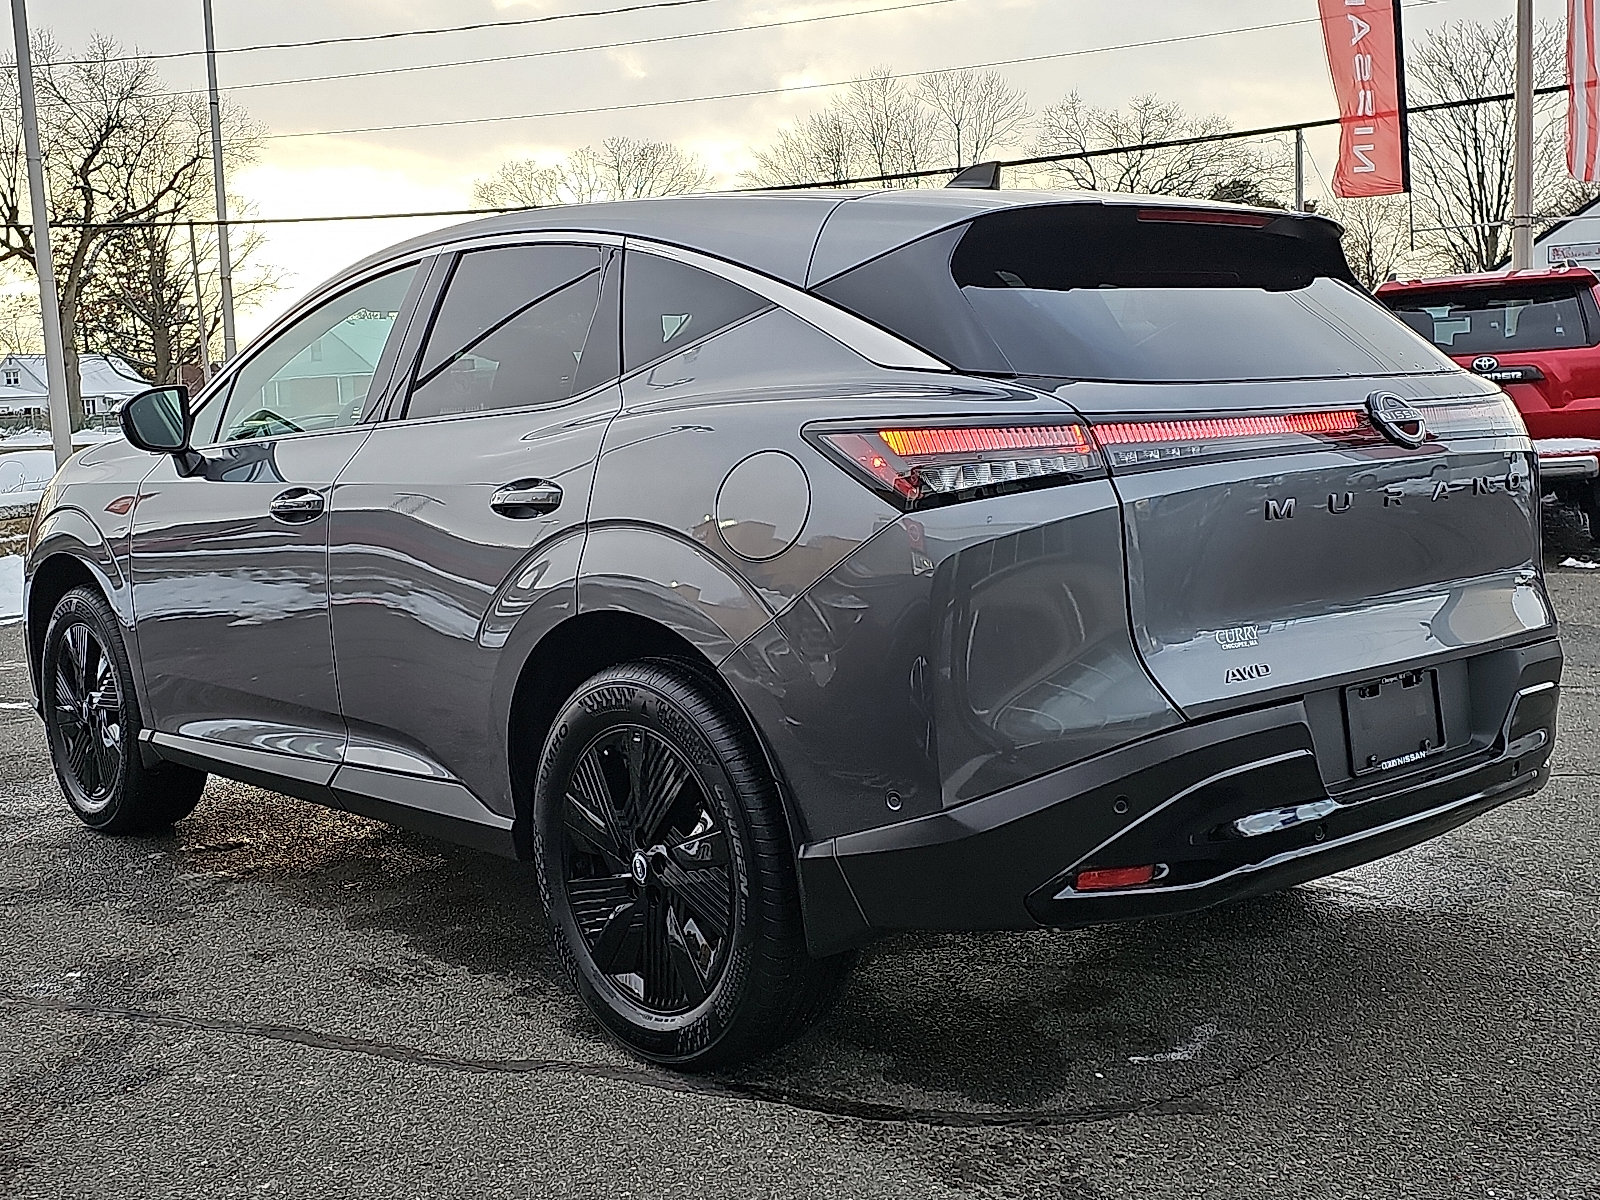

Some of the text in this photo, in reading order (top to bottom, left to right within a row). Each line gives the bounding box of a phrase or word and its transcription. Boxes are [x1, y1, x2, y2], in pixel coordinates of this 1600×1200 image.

[1264, 471, 1521, 520] MURANO
[1215, 625, 1259, 645] CURRY
[1225, 664, 1271, 684] AWD
